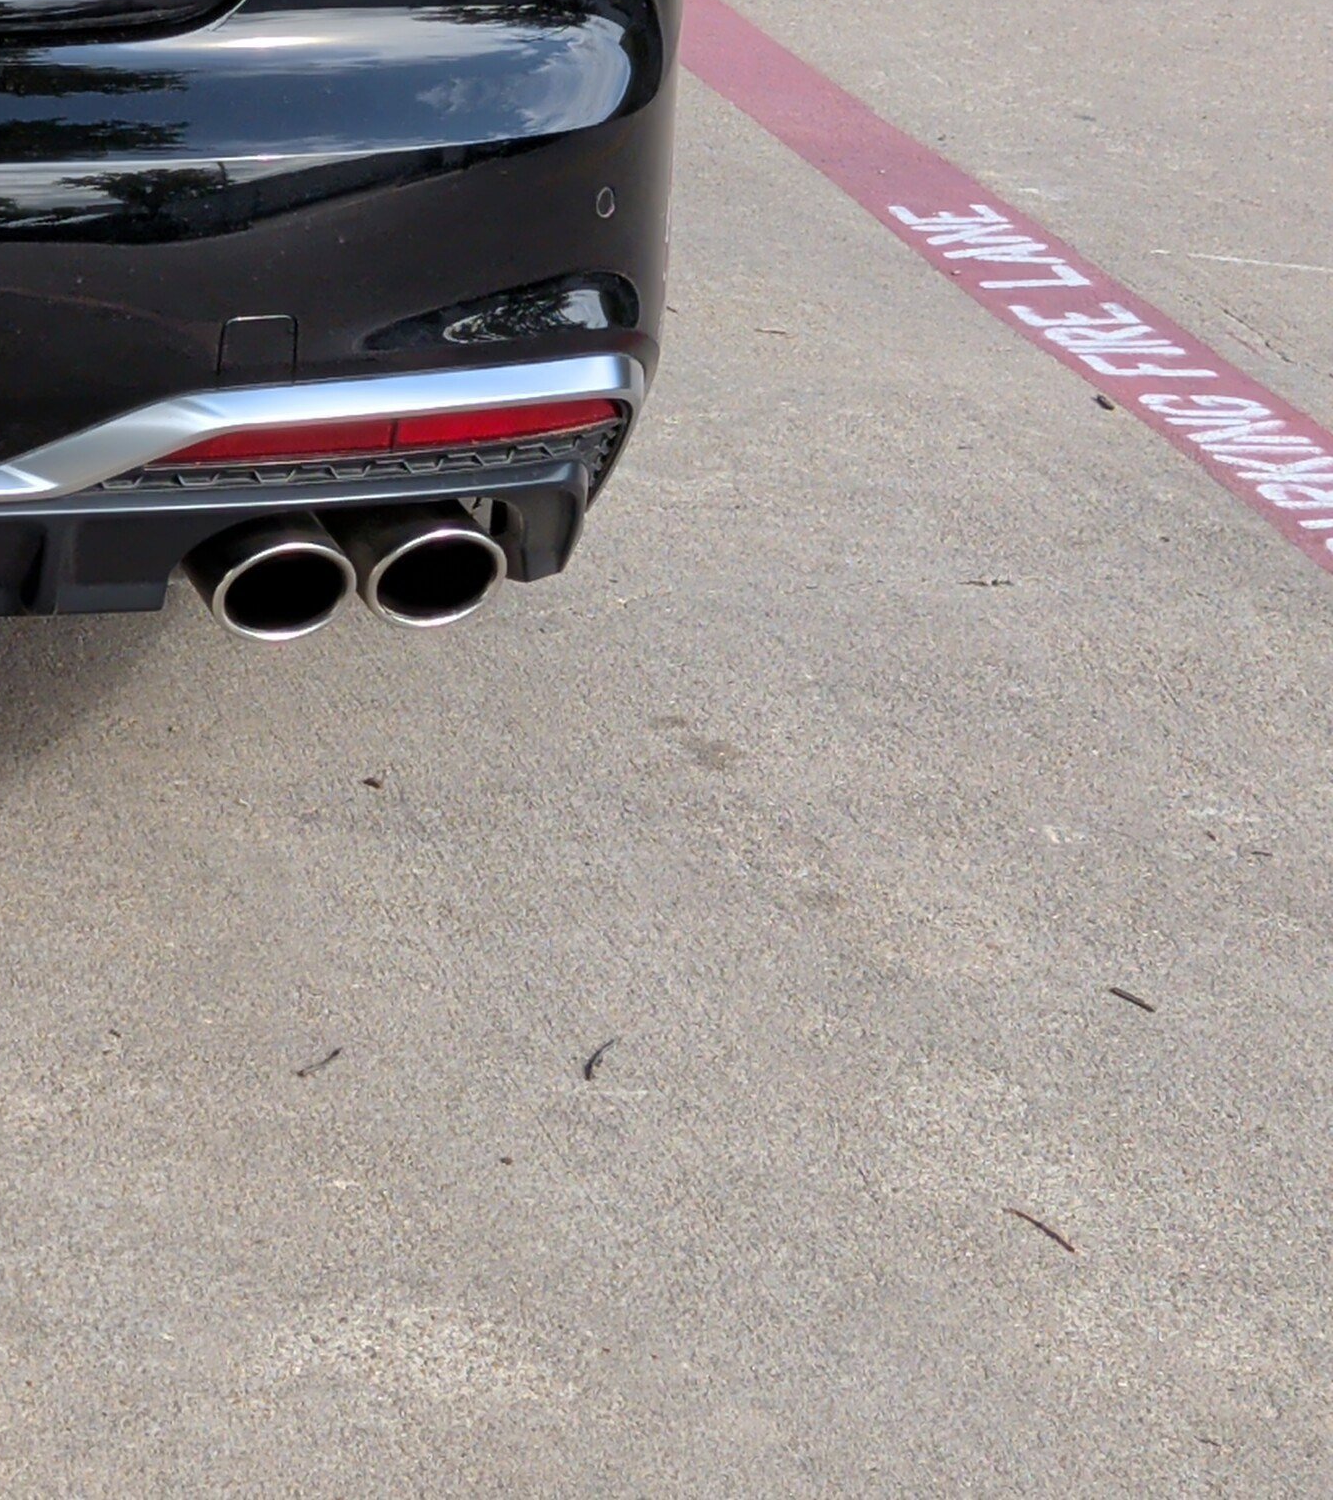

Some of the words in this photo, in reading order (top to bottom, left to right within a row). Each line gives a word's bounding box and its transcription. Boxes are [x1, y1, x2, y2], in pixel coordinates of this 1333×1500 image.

[887, 203, 1092, 290] LANE
[1006, 301, 1219, 378] FIRE
[1137, 393, 1333, 556] RKING
